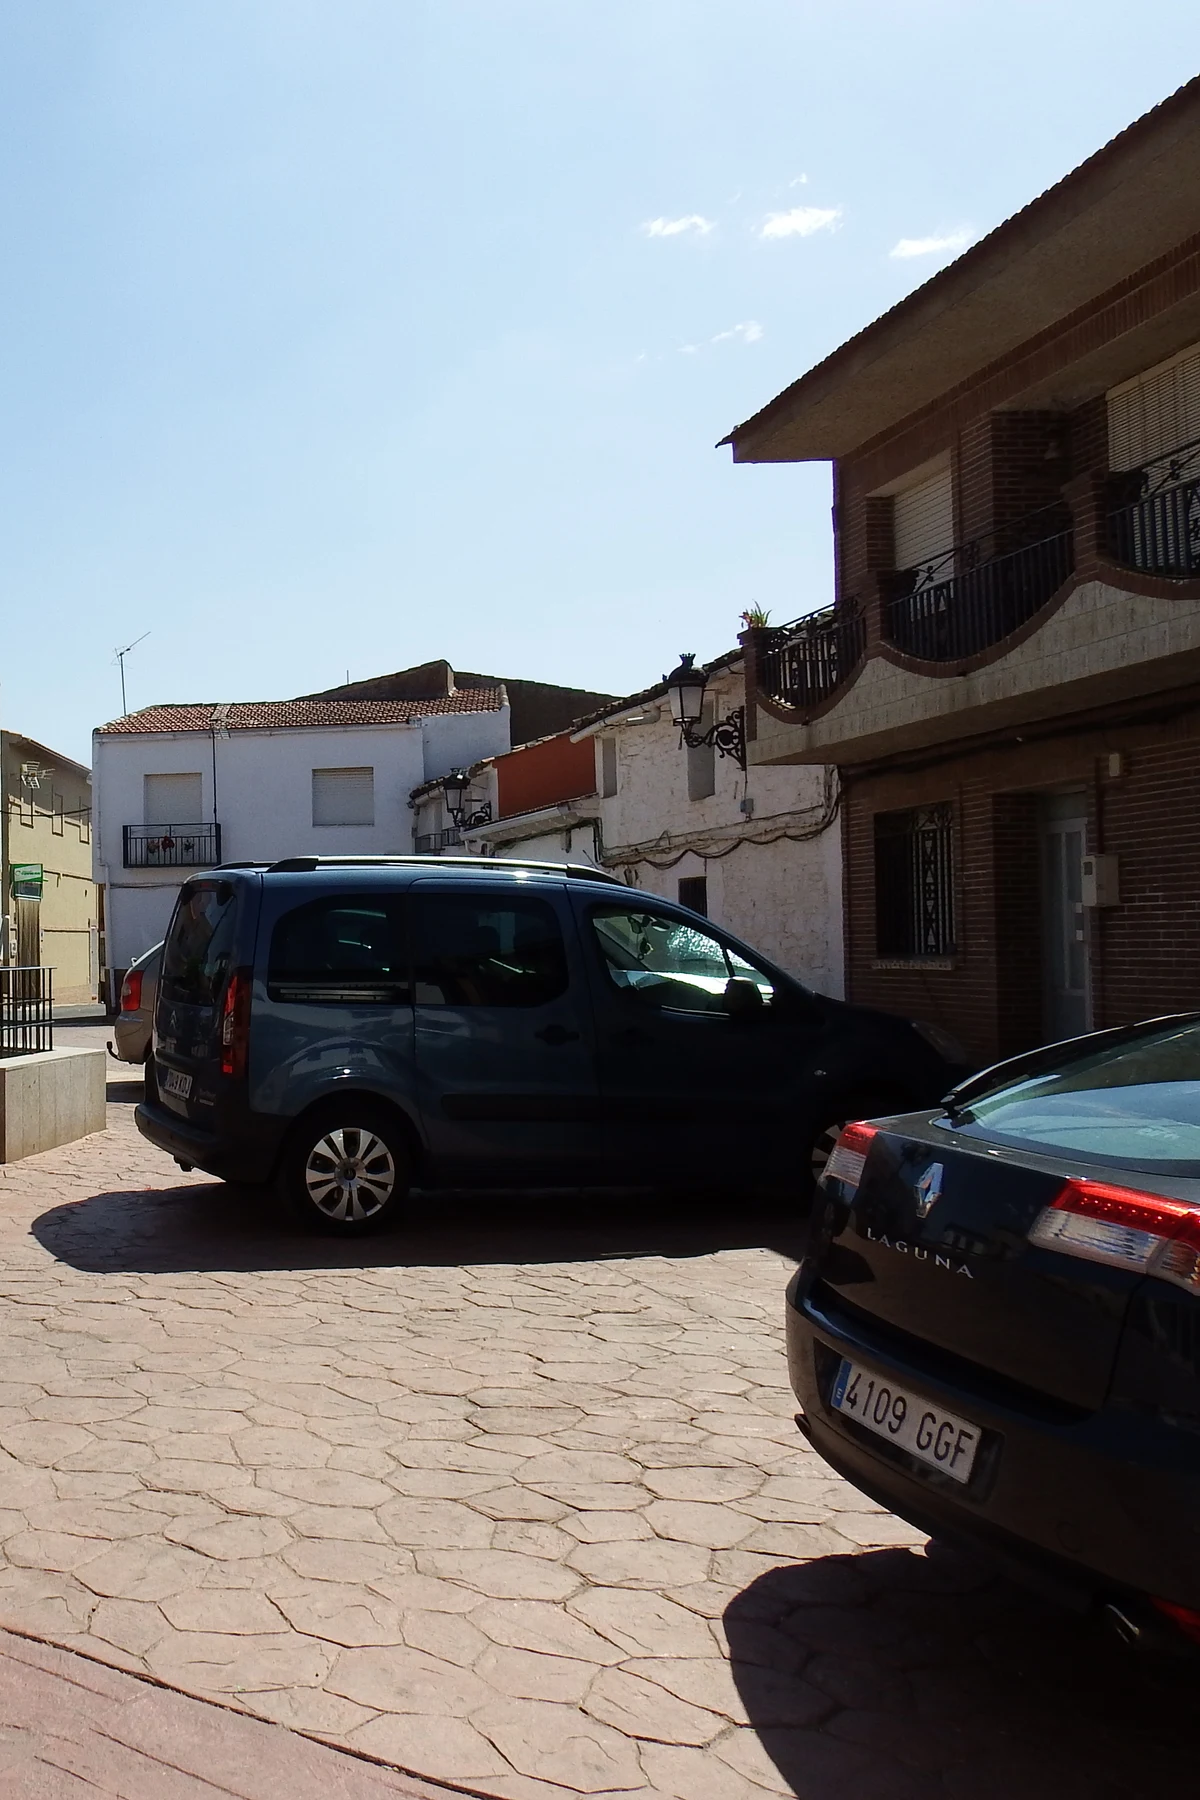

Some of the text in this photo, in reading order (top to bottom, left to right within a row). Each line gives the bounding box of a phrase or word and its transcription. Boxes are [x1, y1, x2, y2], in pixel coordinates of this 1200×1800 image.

[867, 1227, 974, 1279] LAGUNA
[845, 1372, 907, 1434] 4109
[916, 1411, 974, 1469] GGF
